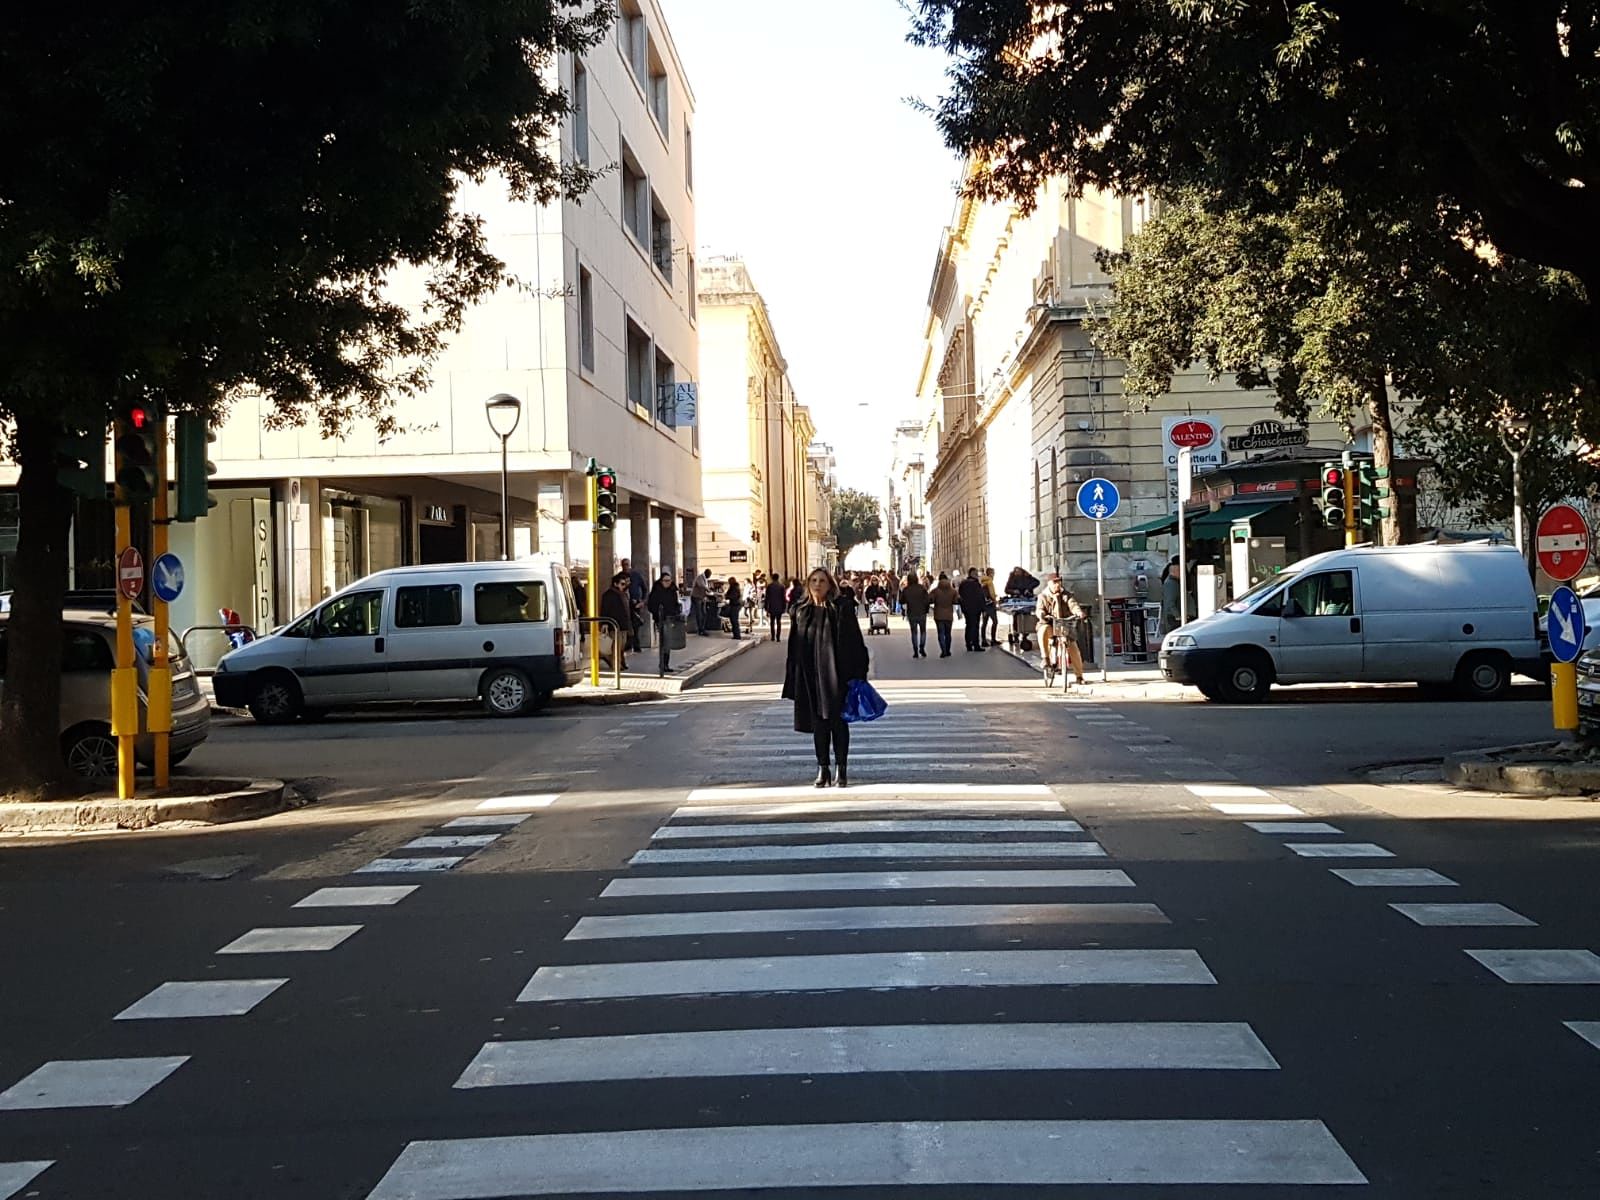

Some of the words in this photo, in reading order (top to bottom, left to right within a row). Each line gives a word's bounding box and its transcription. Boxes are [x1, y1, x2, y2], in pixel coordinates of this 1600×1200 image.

[677, 384, 695, 393] AL
[676, 392, 695, 402] EX
[1253, 422, 1280, 435] BAR
[1171, 432, 1213, 441] VALENTINO
[1168, 454, 1217, 464] Ctteria
